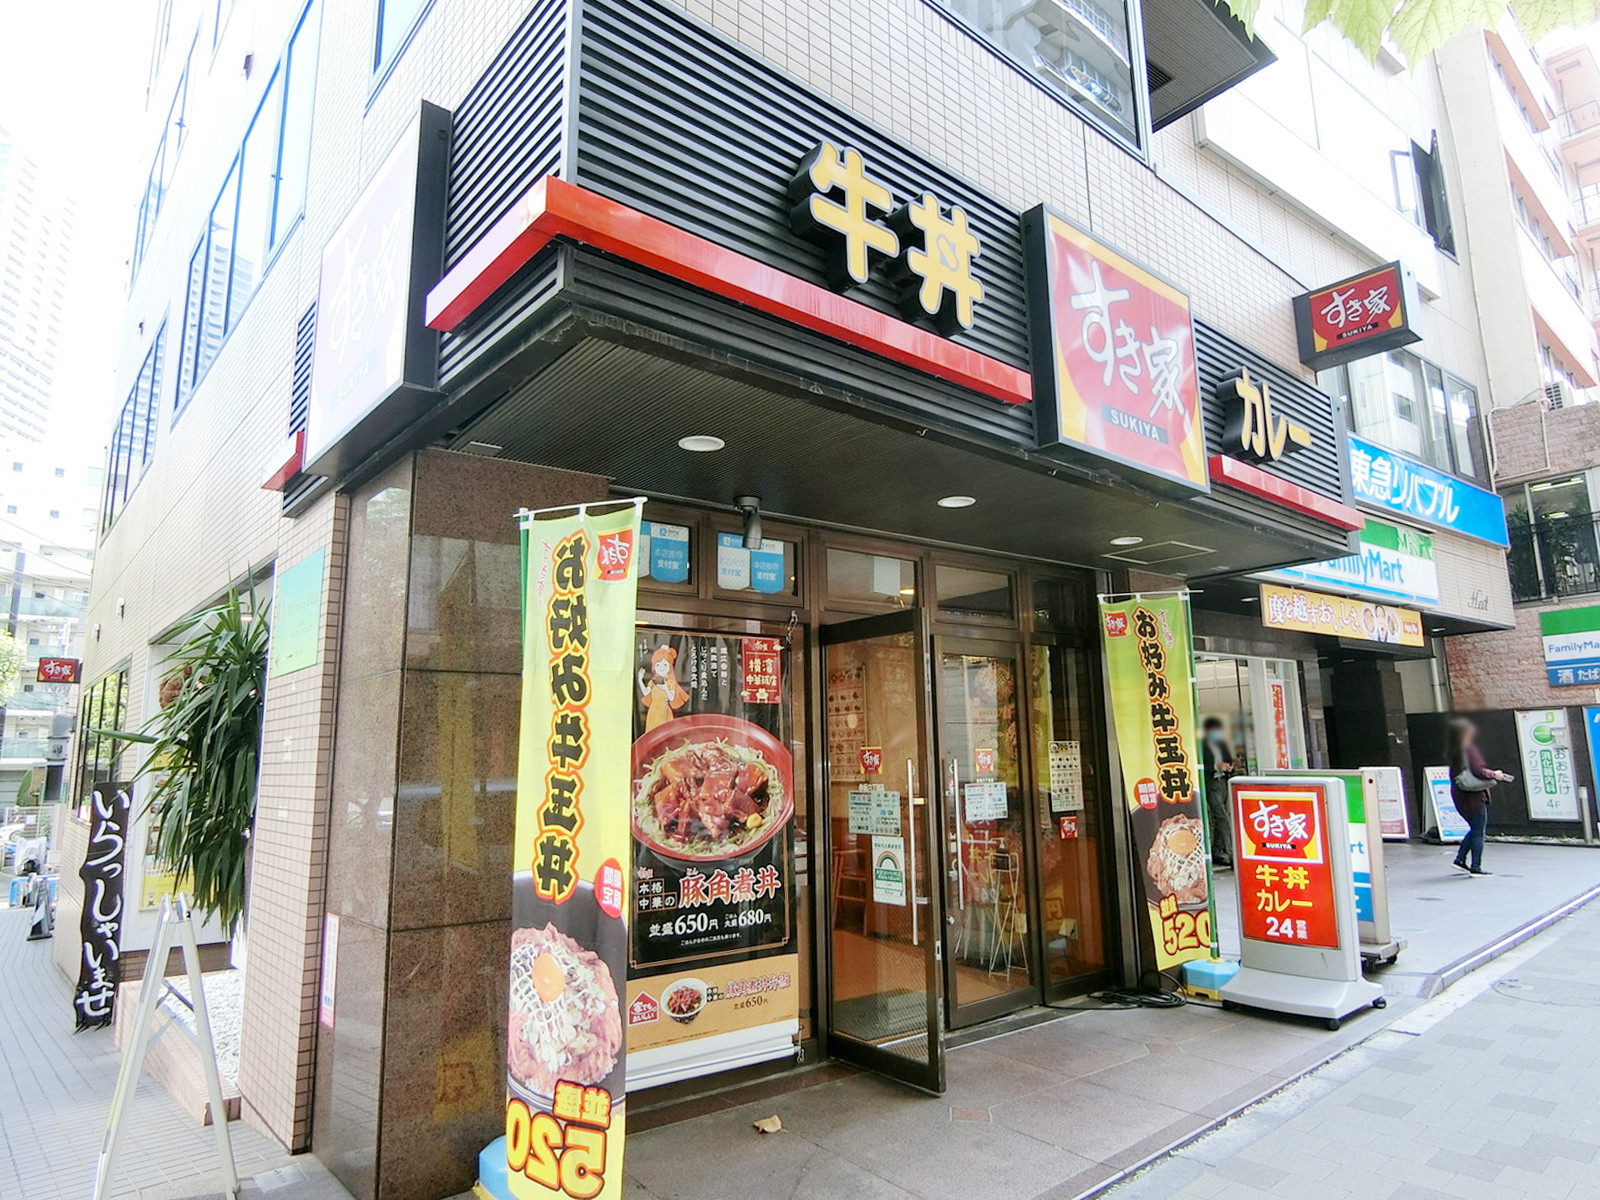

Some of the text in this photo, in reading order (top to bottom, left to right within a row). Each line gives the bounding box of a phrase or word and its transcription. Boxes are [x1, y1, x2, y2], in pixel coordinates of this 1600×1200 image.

[806, 139, 985, 331] 牛丼
[1320, 286, 1392, 328] すき家
[1069, 258, 1189, 420] すき家
[1341, 324, 1374, 339] SUKIYA
[1110, 408, 1161, 441] SUKIYA
[1234, 366, 1313, 462] カレー
[1349, 448, 1461, 524] 東急リバブル
[1105, 614, 1126, 631] すき家
[1557, 668, 1575, 684] 酒
[1134, 606, 1192, 802] お好み牛玉丼
[862, 750, 880, 768] すき家
[1528, 749, 1543, 795] クリニック
[1553, 747, 1572, 795] おおたけ
[1249, 800, 1309, 844] すき家
[1546, 799, 1561, 809] 4F
[638, 880, 663, 894] 本格
[678, 864, 782, 909] 豚角煮丼
[1255, 864, 1310, 890] 牛丼
[77, 789, 130, 1018] いらっしゃいませ
[638, 896, 676, 910] 中華の
[1256, 889, 1313, 913] カレー
[1163, 911, 1212, 956] 520
[1265, 916, 1308, 940] 24 営業
